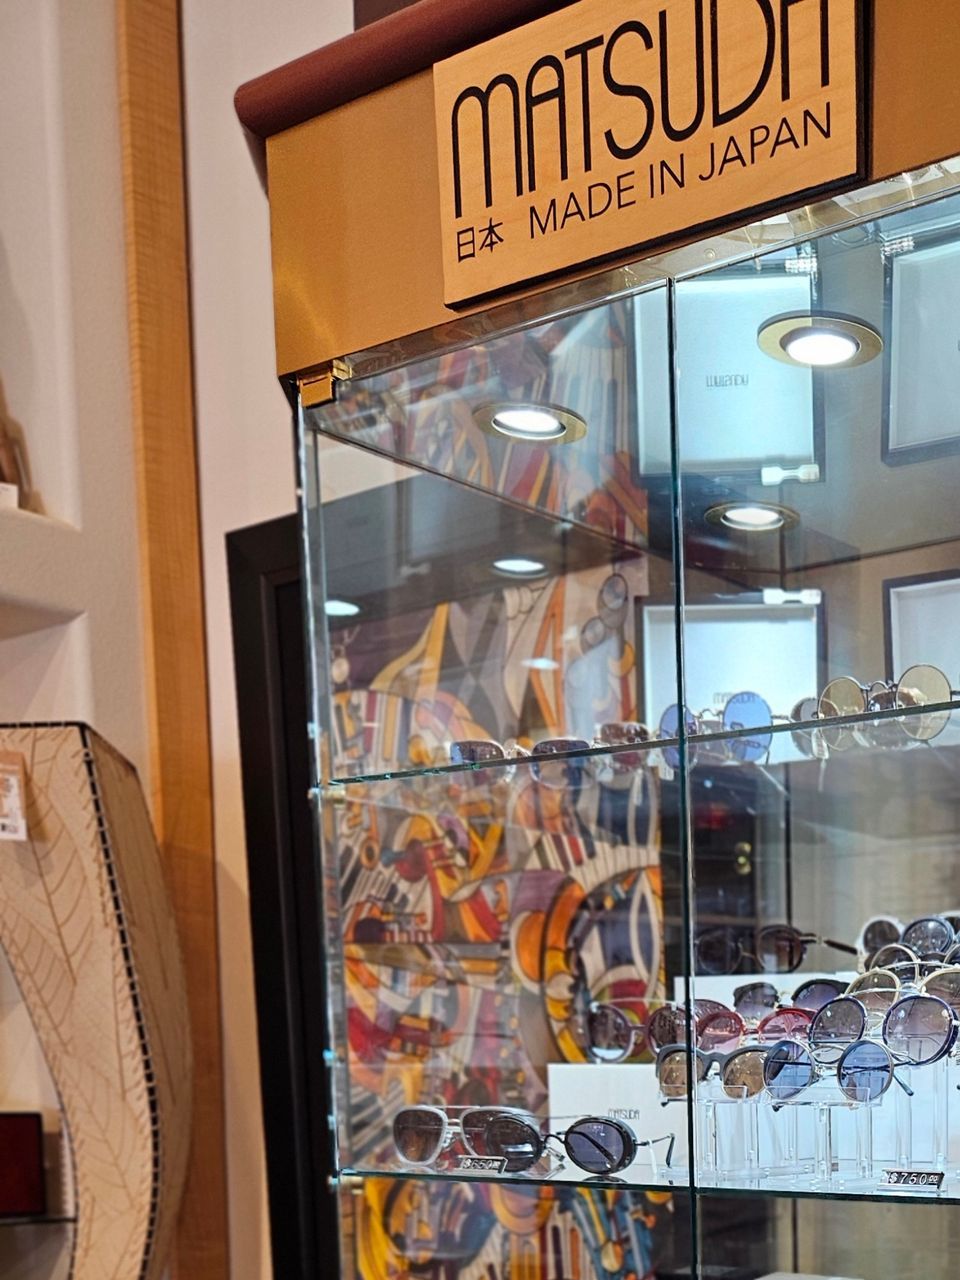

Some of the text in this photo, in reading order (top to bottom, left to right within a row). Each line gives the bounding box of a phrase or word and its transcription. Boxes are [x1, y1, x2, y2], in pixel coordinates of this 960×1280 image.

[451, 0, 830, 219] MATSUDA
[529, 101, 831, 239] MADE IN JAPAN
[456, 217, 504, 263] 日本
